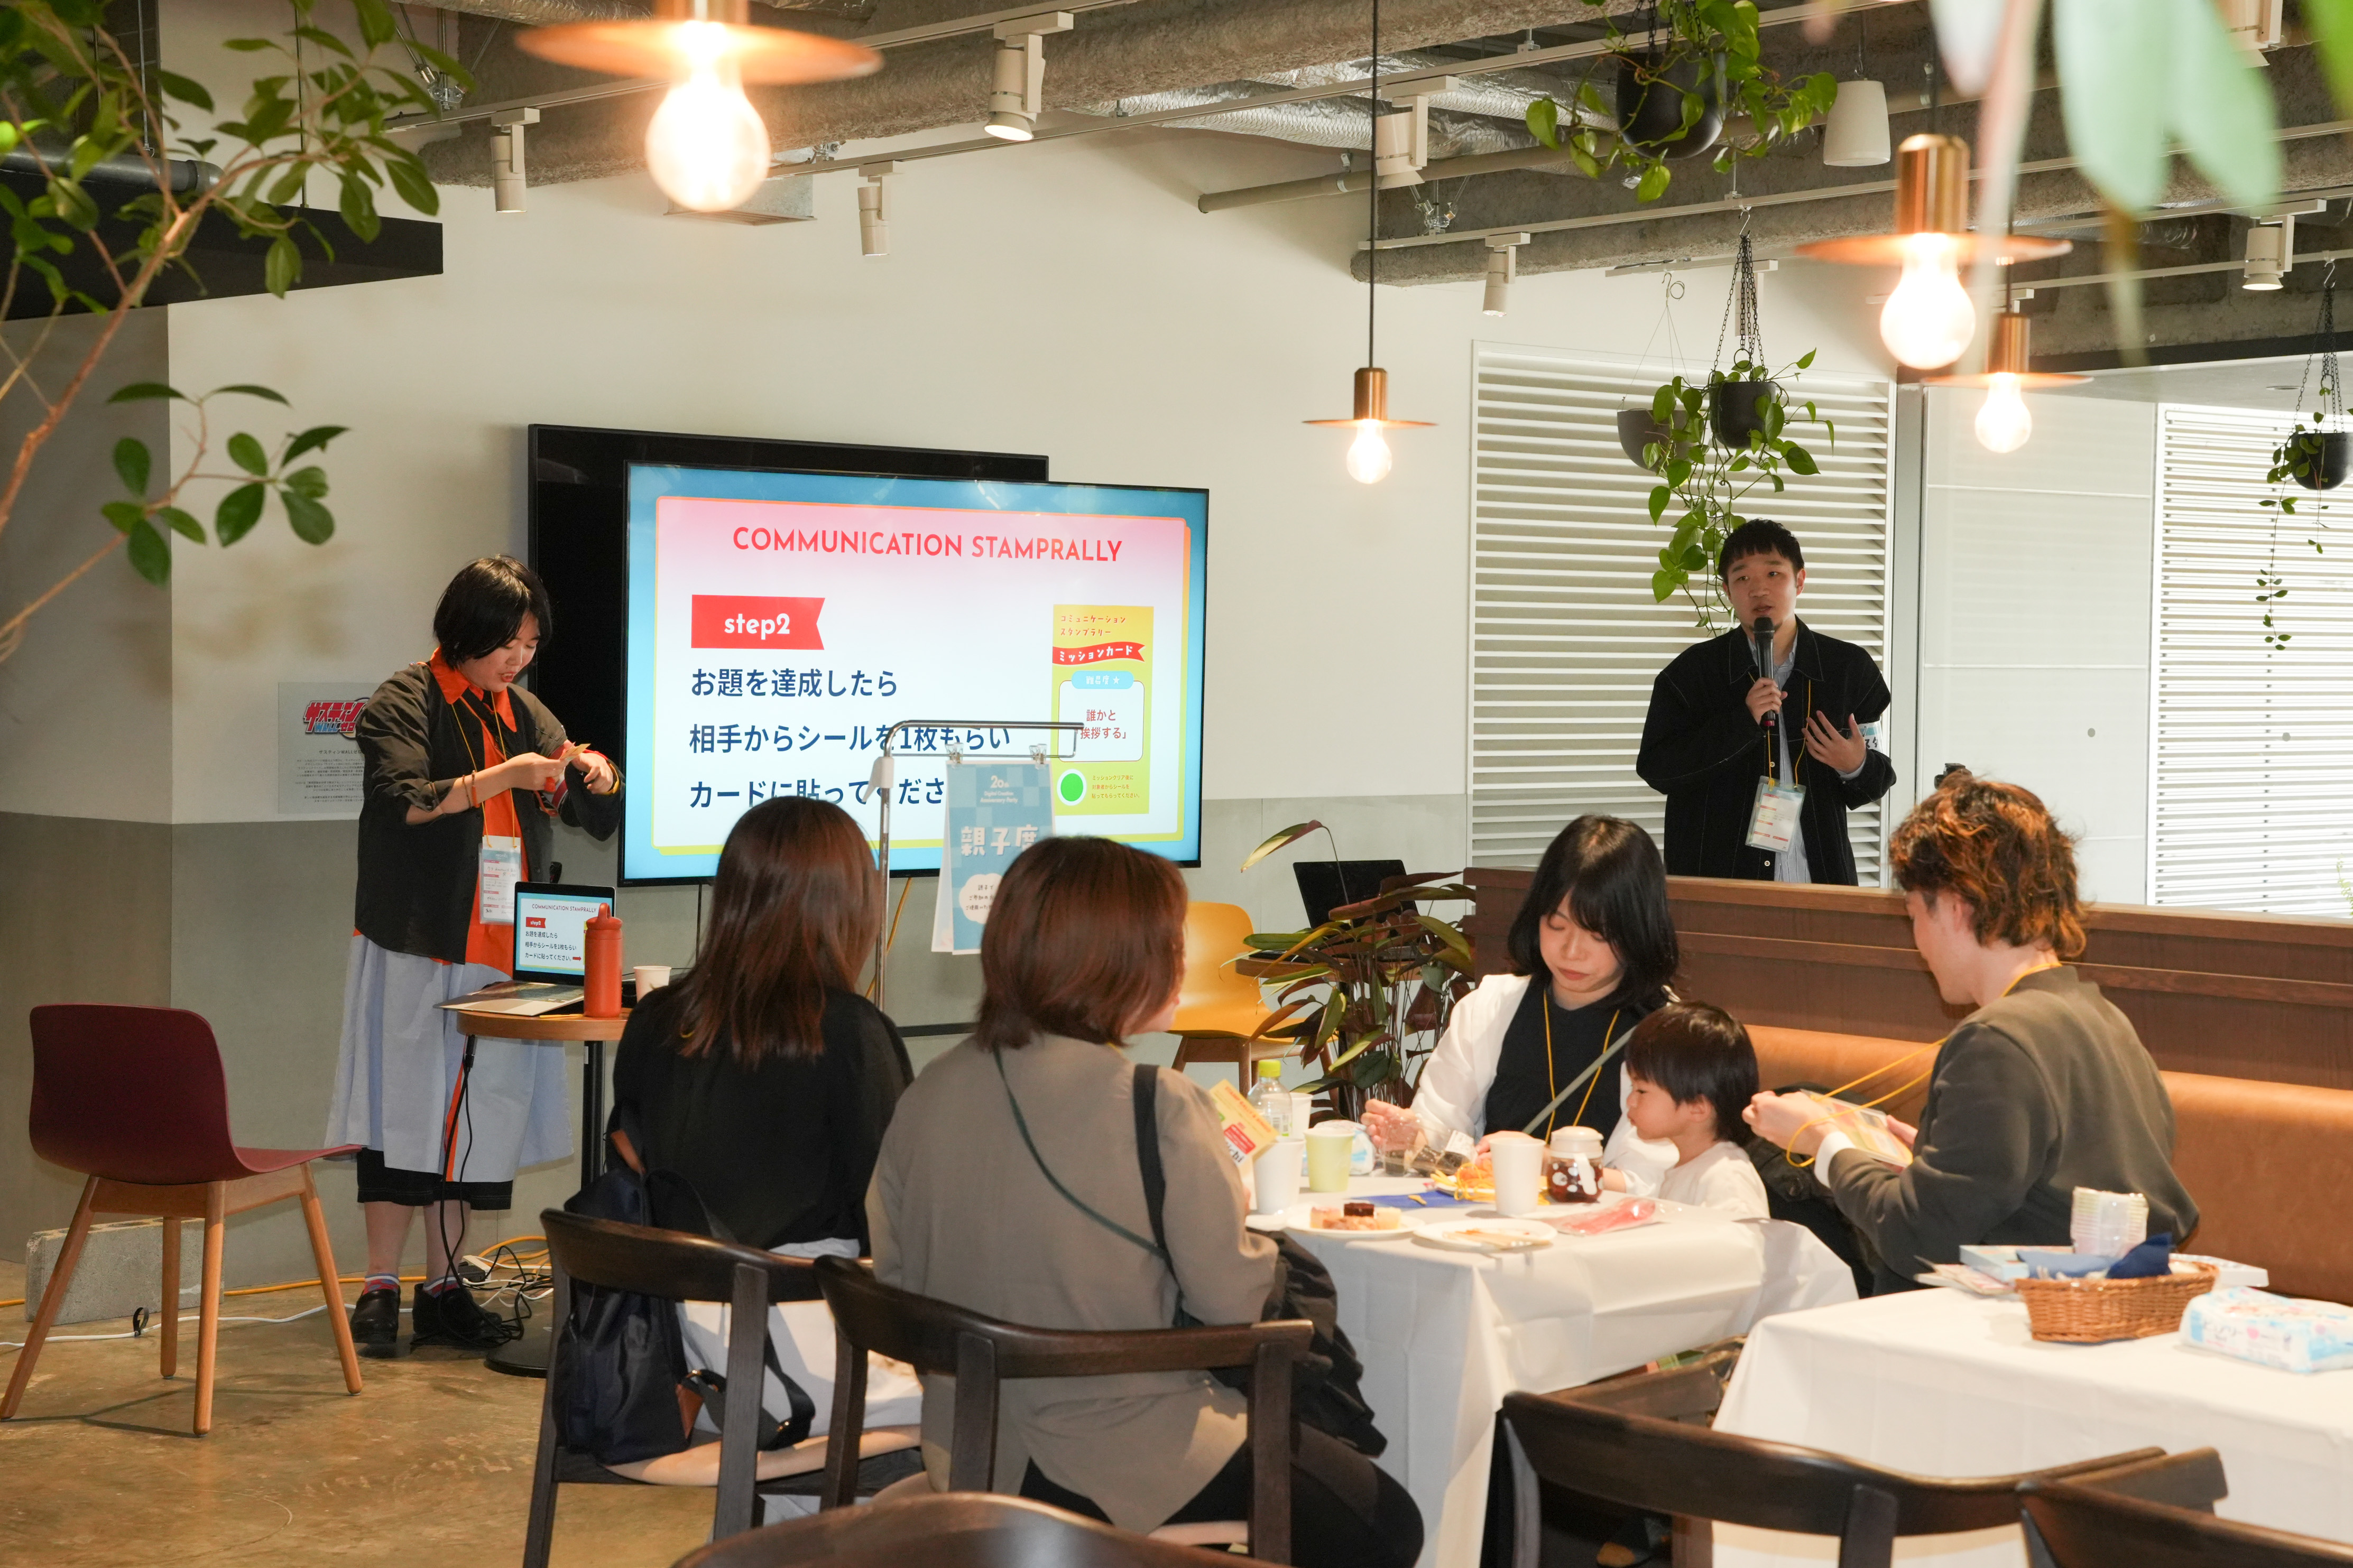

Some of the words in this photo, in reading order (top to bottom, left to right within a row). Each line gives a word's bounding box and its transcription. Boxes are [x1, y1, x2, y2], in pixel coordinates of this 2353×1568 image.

[733, 526, 962, 557] COMMUNICATION
[972, 535, 1122, 561] STAMPRALLY
[1061, 615, 1126, 624] コミュニケーション
[724, 613, 790, 640] step2
[1060, 628, 1111, 636] スタンプラリー
[1059, 645, 1133, 662] ミッションカード
[691, 668, 897, 697] お題を達成したら
[1086, 709, 1116, 721] 誰かと
[525, 941, 577, 951] 相手からシールを1枚もらい
[525, 952, 571, 961] カードに貼ってください。
